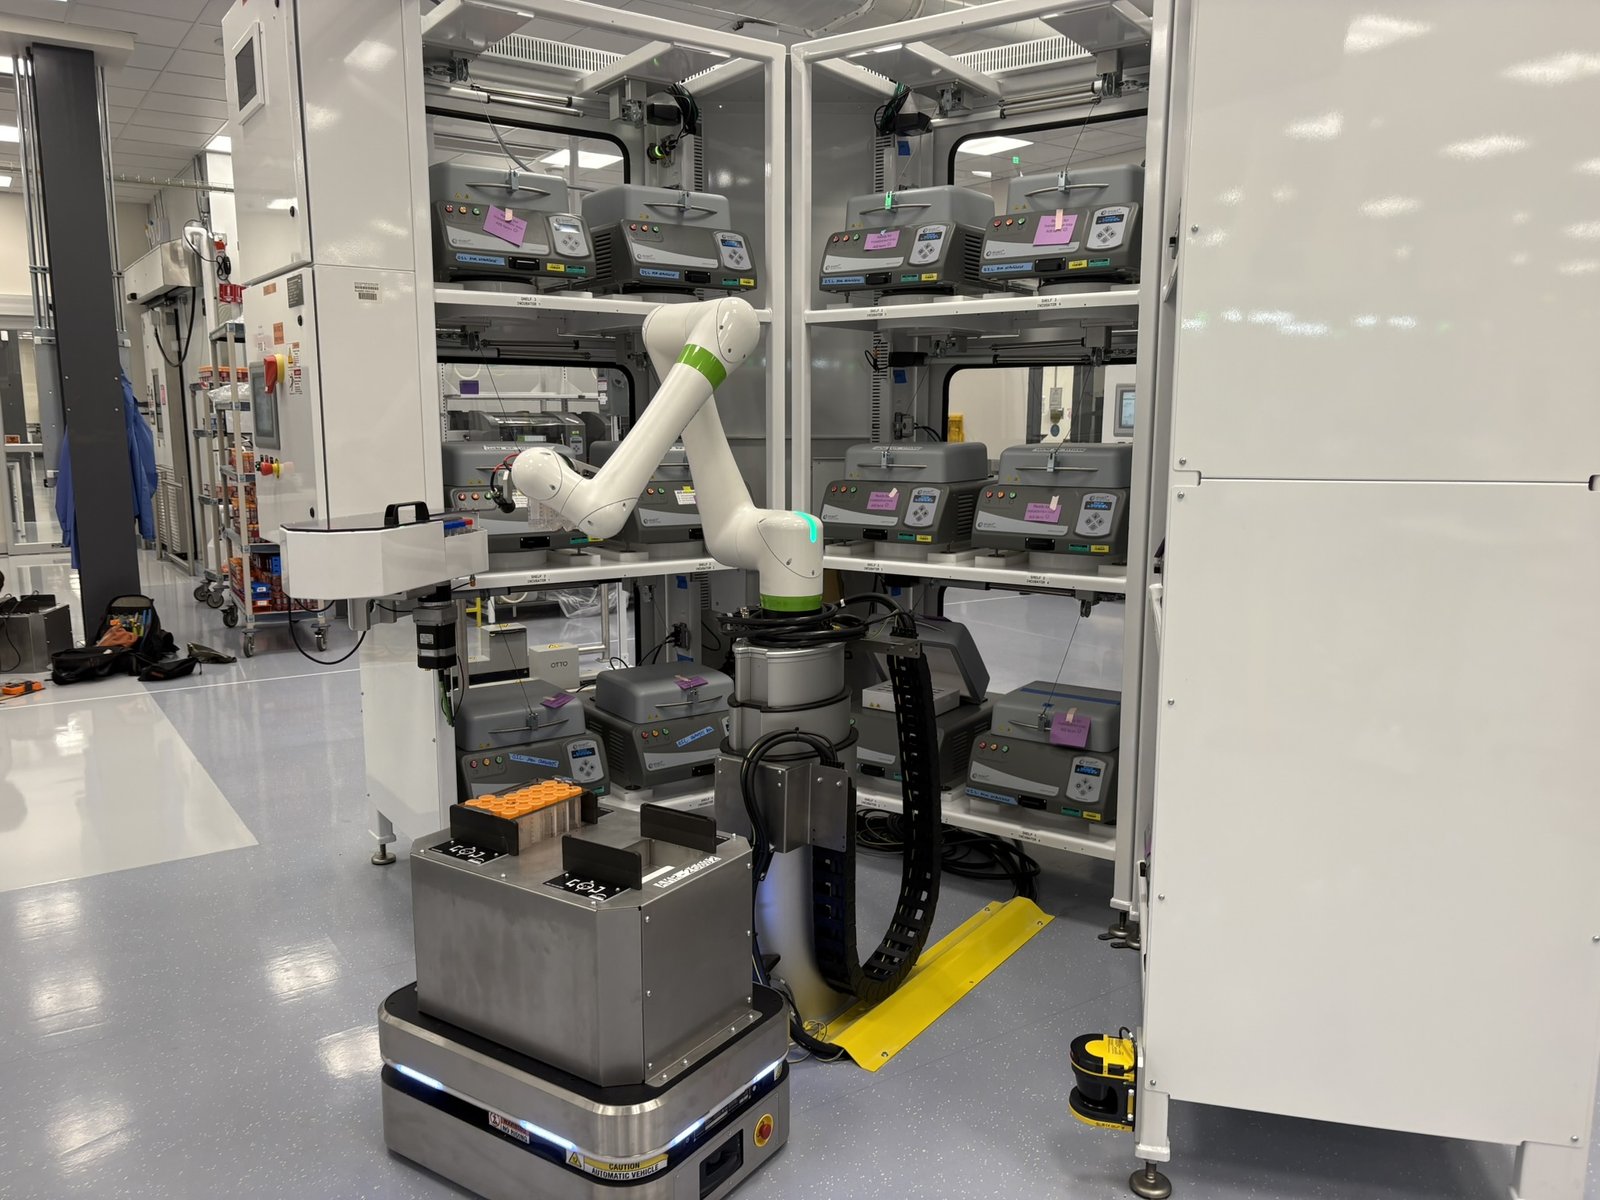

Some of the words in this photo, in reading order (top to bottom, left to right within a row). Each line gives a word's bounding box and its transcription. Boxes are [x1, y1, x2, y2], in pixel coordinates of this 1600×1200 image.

[550, 660, 568, 669] OTTO
[592, 1168, 630, 1180] AUTOMATIC
[632, 1163, 659, 1177] VEHICLE
[608, 1163, 640, 1171] CAUTION
